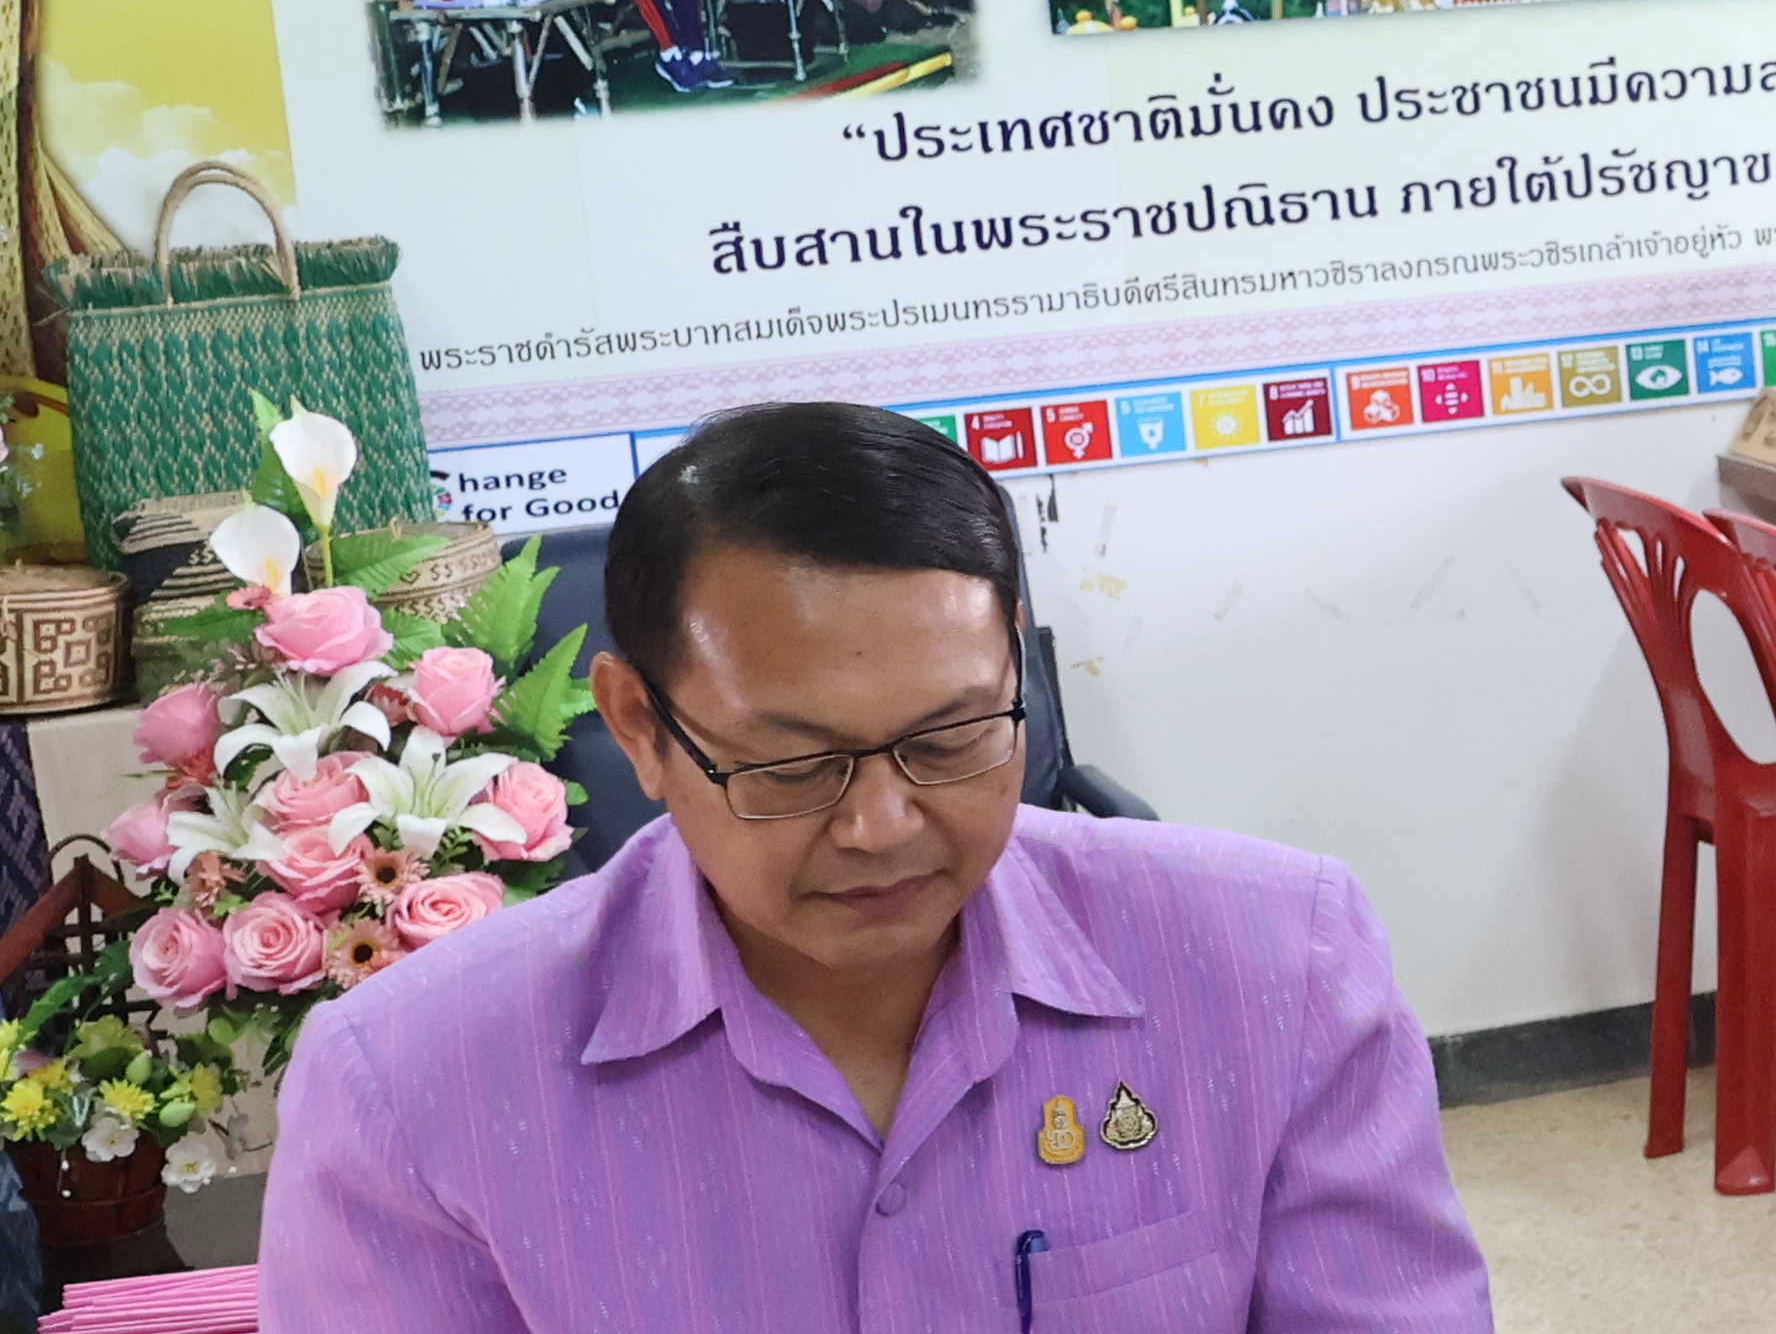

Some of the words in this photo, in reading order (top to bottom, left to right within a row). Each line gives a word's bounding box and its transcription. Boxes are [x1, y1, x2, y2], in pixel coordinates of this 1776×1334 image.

[708, 181, 1379, 274] สืบสานในพระราชปณิธาน
[525, 489, 620, 519] Good
